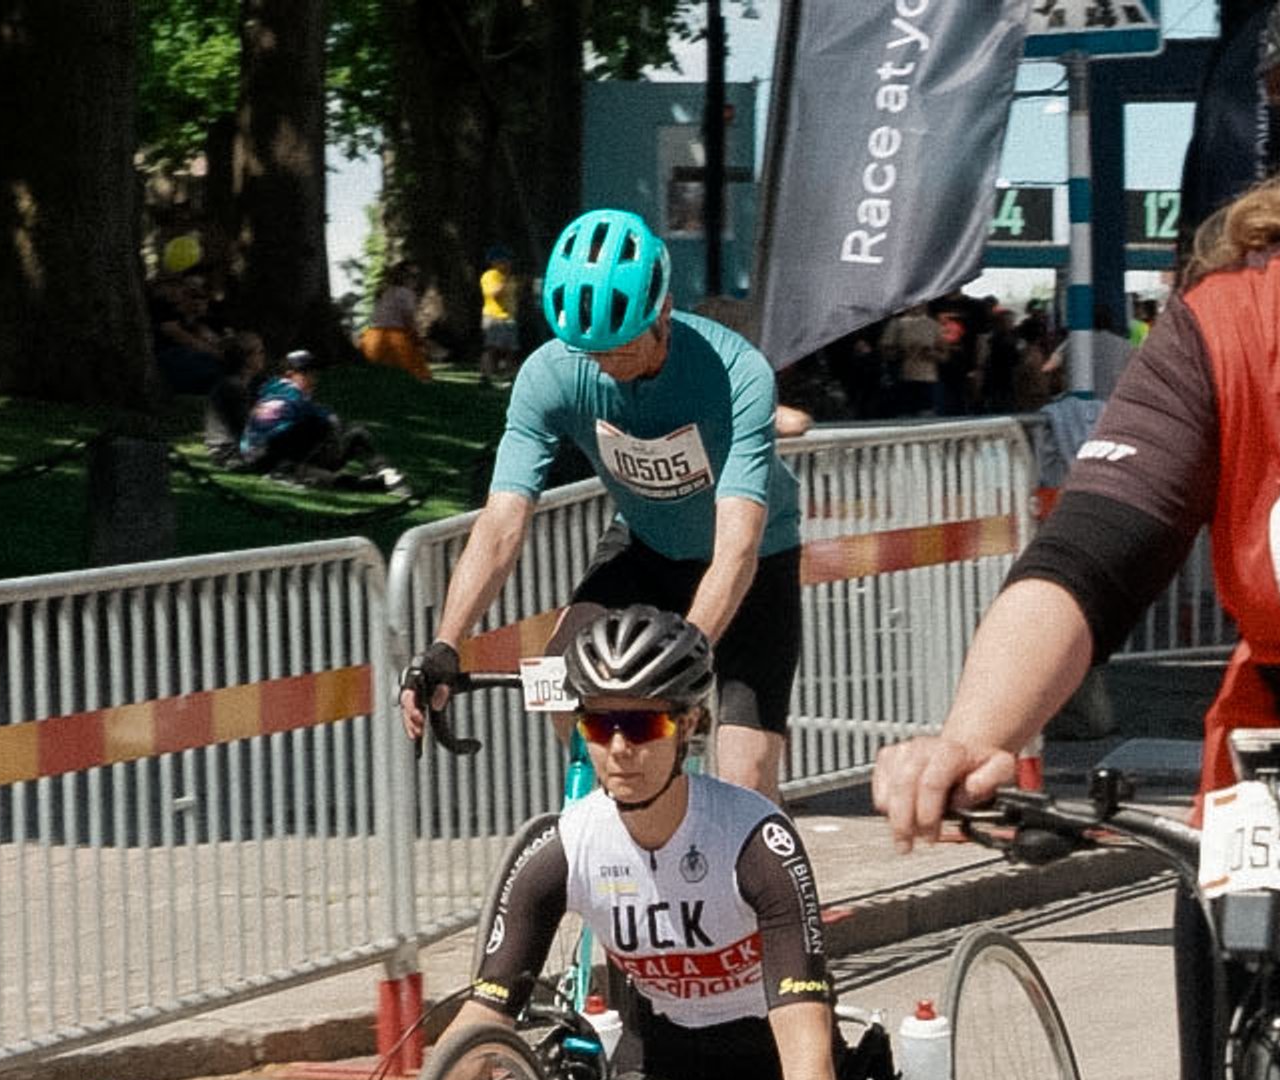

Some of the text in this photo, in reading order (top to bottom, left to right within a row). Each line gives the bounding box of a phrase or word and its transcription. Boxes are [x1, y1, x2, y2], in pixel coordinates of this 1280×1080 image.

[840, 125, 903, 265] Race
[876, 61, 918, 114] at
[1144, 192, 1181, 238] 12
[614, 450, 691, 482] 10505
[612, 899, 715, 952] UCK
[719, 939, 758, 971] CK
